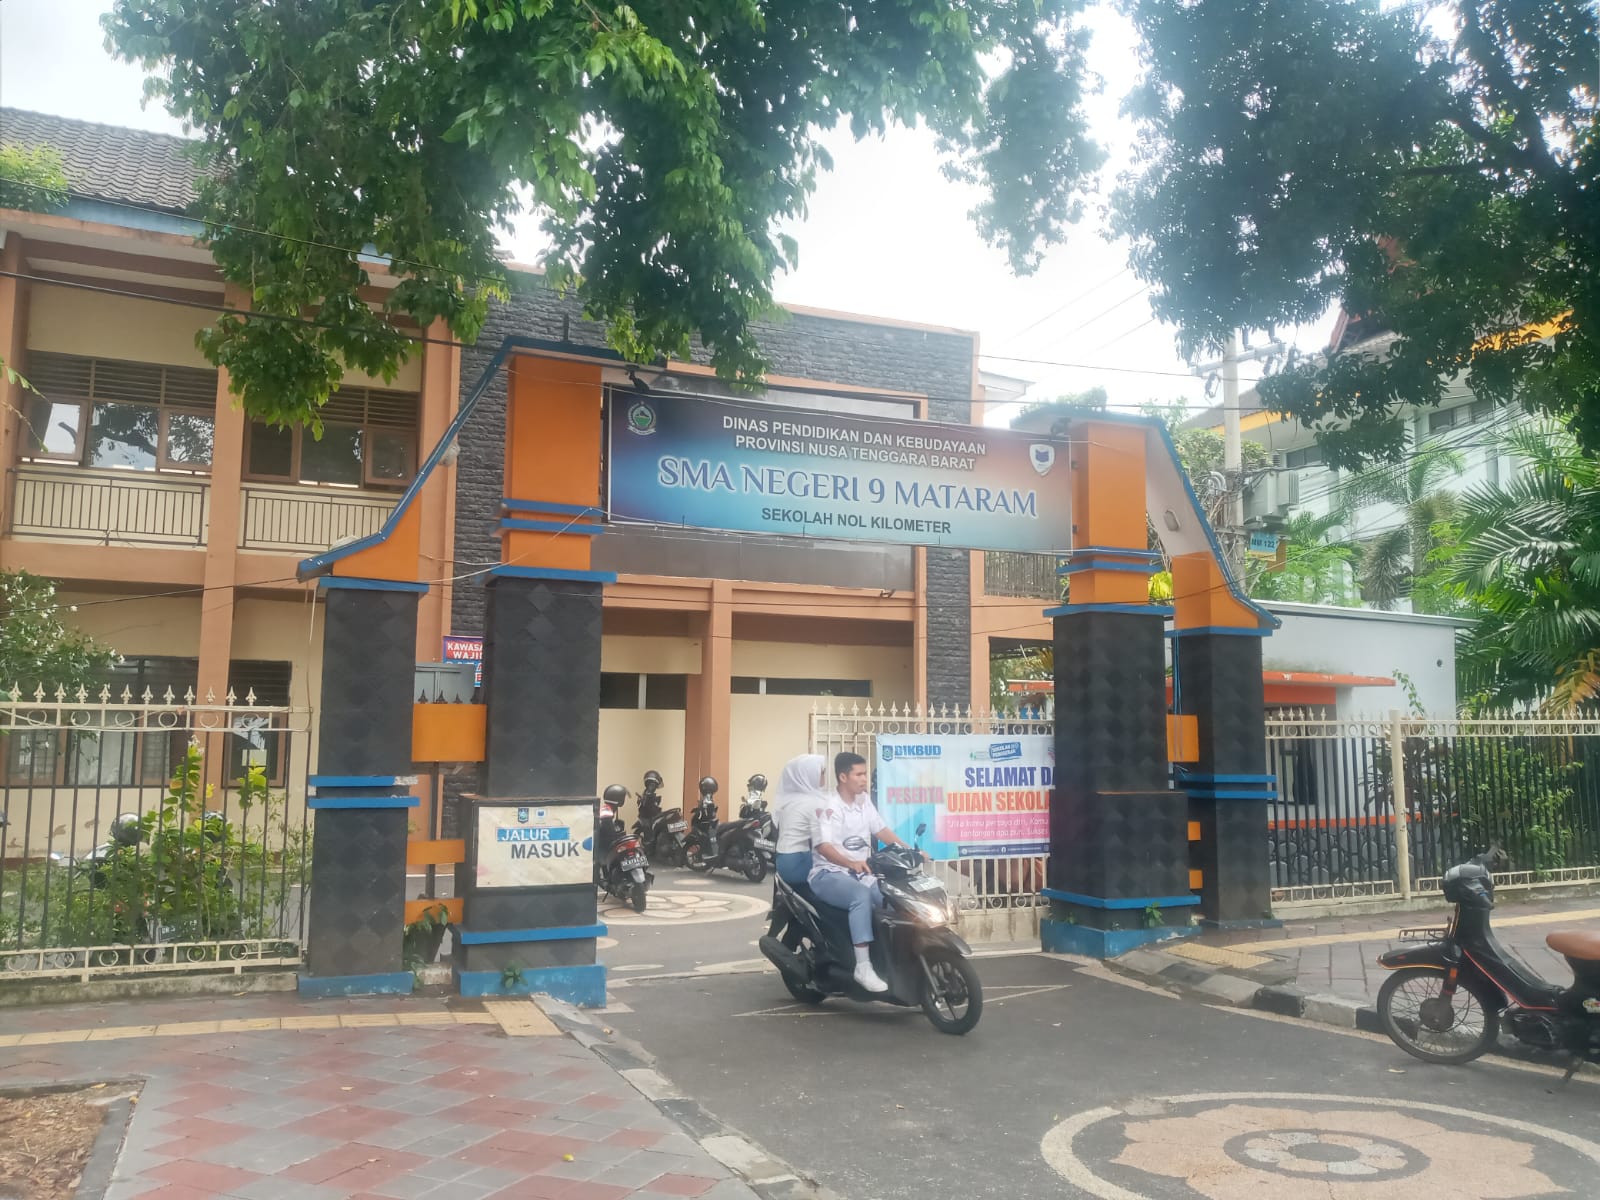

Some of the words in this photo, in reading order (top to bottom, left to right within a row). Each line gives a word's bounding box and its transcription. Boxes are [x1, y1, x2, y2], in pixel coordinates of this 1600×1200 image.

[722, 415, 768, 433] DINAS
[772, 420, 859, 443] PENDIDIKAN
[863, 431, 892, 446] DAN
[897, 435, 986, 456] KEBUDAYAAN
[735, 435, 804, 454] PROVINSI
[808, 444, 848, 458] NUSA
[851, 447, 928, 467] TENGGARA
[931, 455, 975, 470] BARAT
[659, 457, 735, 491] SMA
[741, 465, 860, 503] NEGERI
[868, 477, 886, 504] 9
[895, 479, 1038, 518] MATARAM
[761, 507, 833, 526] SEKOLAH
[837, 513, 867, 529] NOL
[871, 516, 951, 534] KILOMETER
[964, 766, 1037, 788] SELAMAT
[887, 787, 944, 803] PESERTA
[947, 793, 993, 812] UJIAN
[502, 828, 550, 841] JALUR
[511, 842, 580, 859] MASUK
